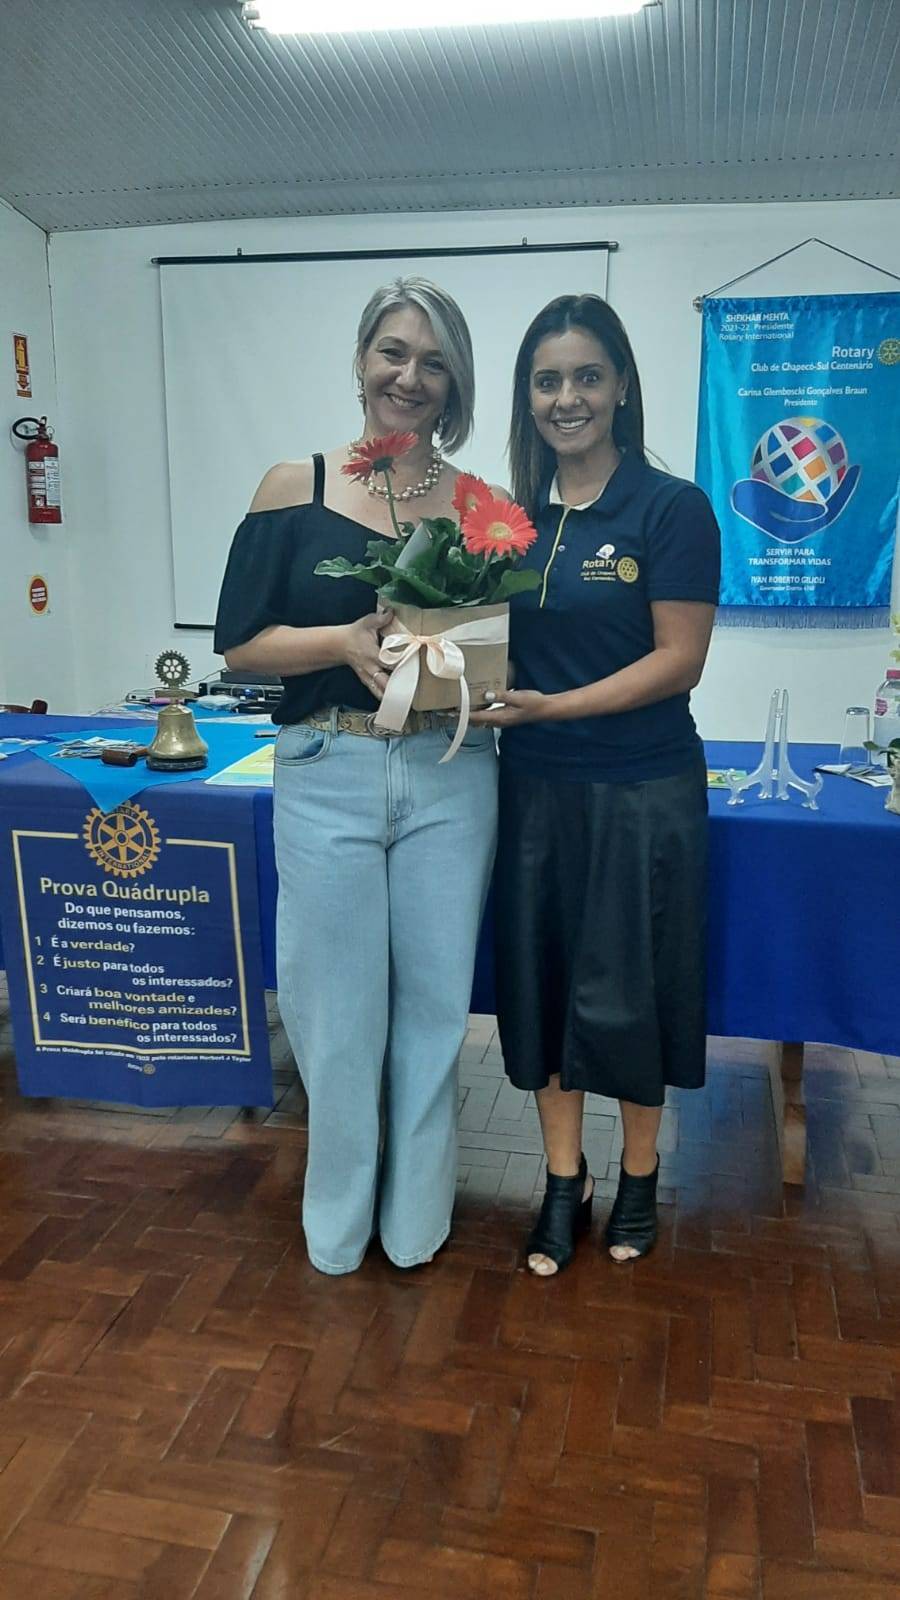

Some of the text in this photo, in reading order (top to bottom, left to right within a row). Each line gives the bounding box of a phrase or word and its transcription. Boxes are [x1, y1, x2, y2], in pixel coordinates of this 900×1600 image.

[763, 312, 790, 321] MEHTA
[832, 345, 875, 360] Rotary
[751, 363, 769, 372] Club
[770, 363, 780, 371] de
[844, 385, 868, 395] Braun
[766, 548, 815, 556] SERVIR PARA
[582, 559, 617, 570] Rotary
[748, 558, 832, 566] TRANSFORMAR VIDAS
[750, 576, 768, 584] IVAN
[768, 576, 800, 584] ROBERTO
[95, 847, 151, 870] INTERNATIONAL
[40, 877, 210, 906] Prova Quádrupla
[64, 901, 186, 921] Do que pensamos,
[57, 917, 196, 936] dizemos ou fazemos:
[34, 934, 136, 953] 1 É a verdade?
[36, 953, 165, 974] 2 É justo para todos
[132, 975, 233, 988] os interessados?
[40, 983, 196, 1003] 3 Criará boa vontade e
[88, 1000, 238, 1017] melhores amizades?
[42, 1011, 51, 1022] 4
[59, 1012, 87, 1025] Será
[151, 1020, 180, 1032] para
[181, 1020, 218, 1031] todos
[136, 1032, 238, 1044] os interessados?
